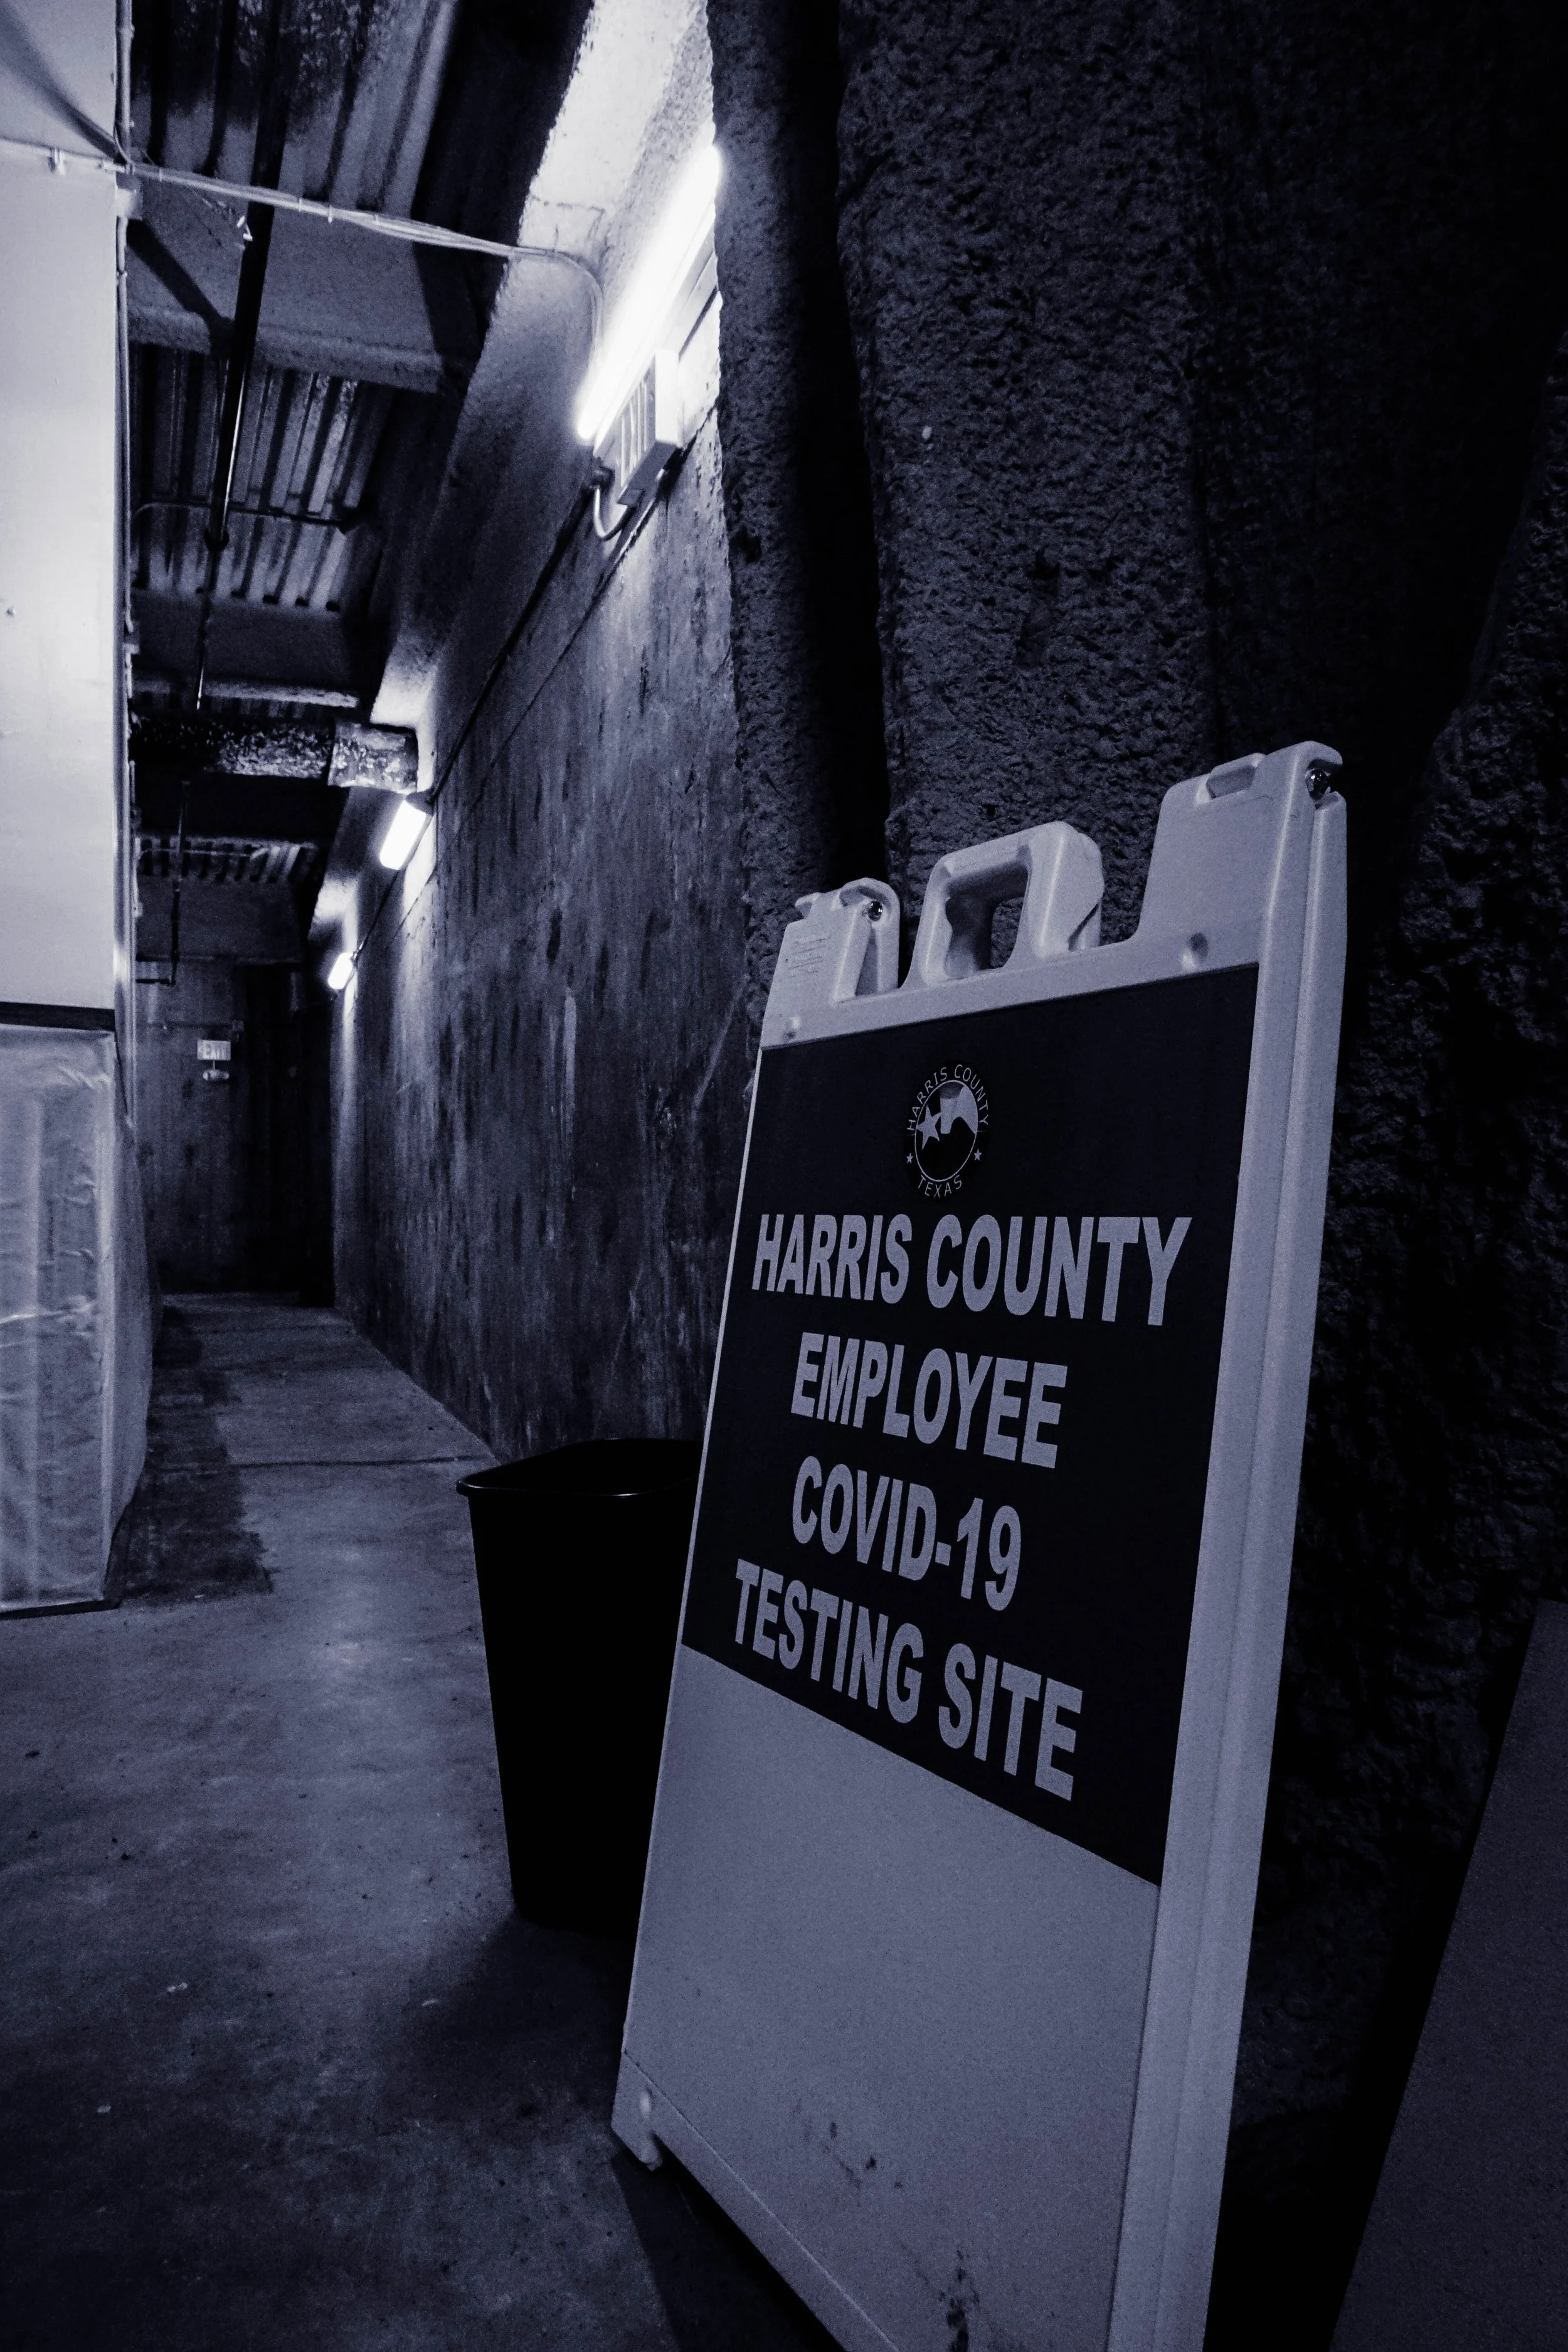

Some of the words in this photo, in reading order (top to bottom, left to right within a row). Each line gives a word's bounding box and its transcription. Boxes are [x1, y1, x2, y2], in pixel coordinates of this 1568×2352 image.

[906, 1066, 948, 1131] HARRIS
[954, 1064, 989, 1126] COUNTY
[918, 1174, 962, 1198] TEXAS
[751, 1214, 913, 1304] HARRIS
[926, 1214, 1192, 1326] COUNTY
[790, 1332, 1068, 1469] EMPLOYEE
[791, 1455, 1022, 1612] COVID-19
[734, 1558, 924, 1724] TESTING
[937, 1642, 1084, 1801] SITE
